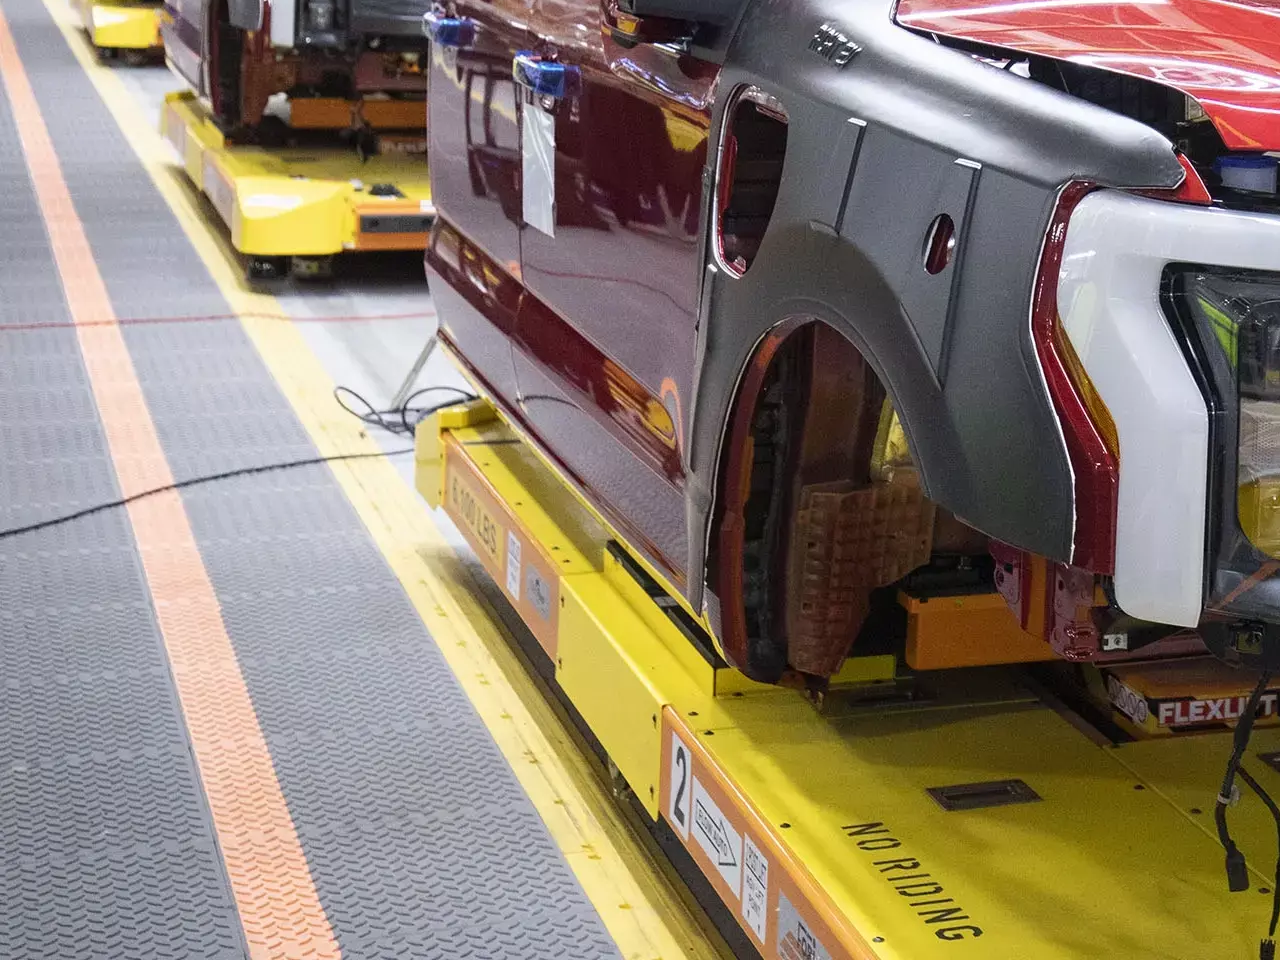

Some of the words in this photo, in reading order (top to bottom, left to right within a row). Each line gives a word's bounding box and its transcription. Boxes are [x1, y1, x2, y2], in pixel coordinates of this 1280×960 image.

[1159, 693, 1278, 726] FLEXLIT
[675, 745, 687, 828] 2
[841, 822, 902, 851] NO
[873, 857, 983, 941] RIDING
